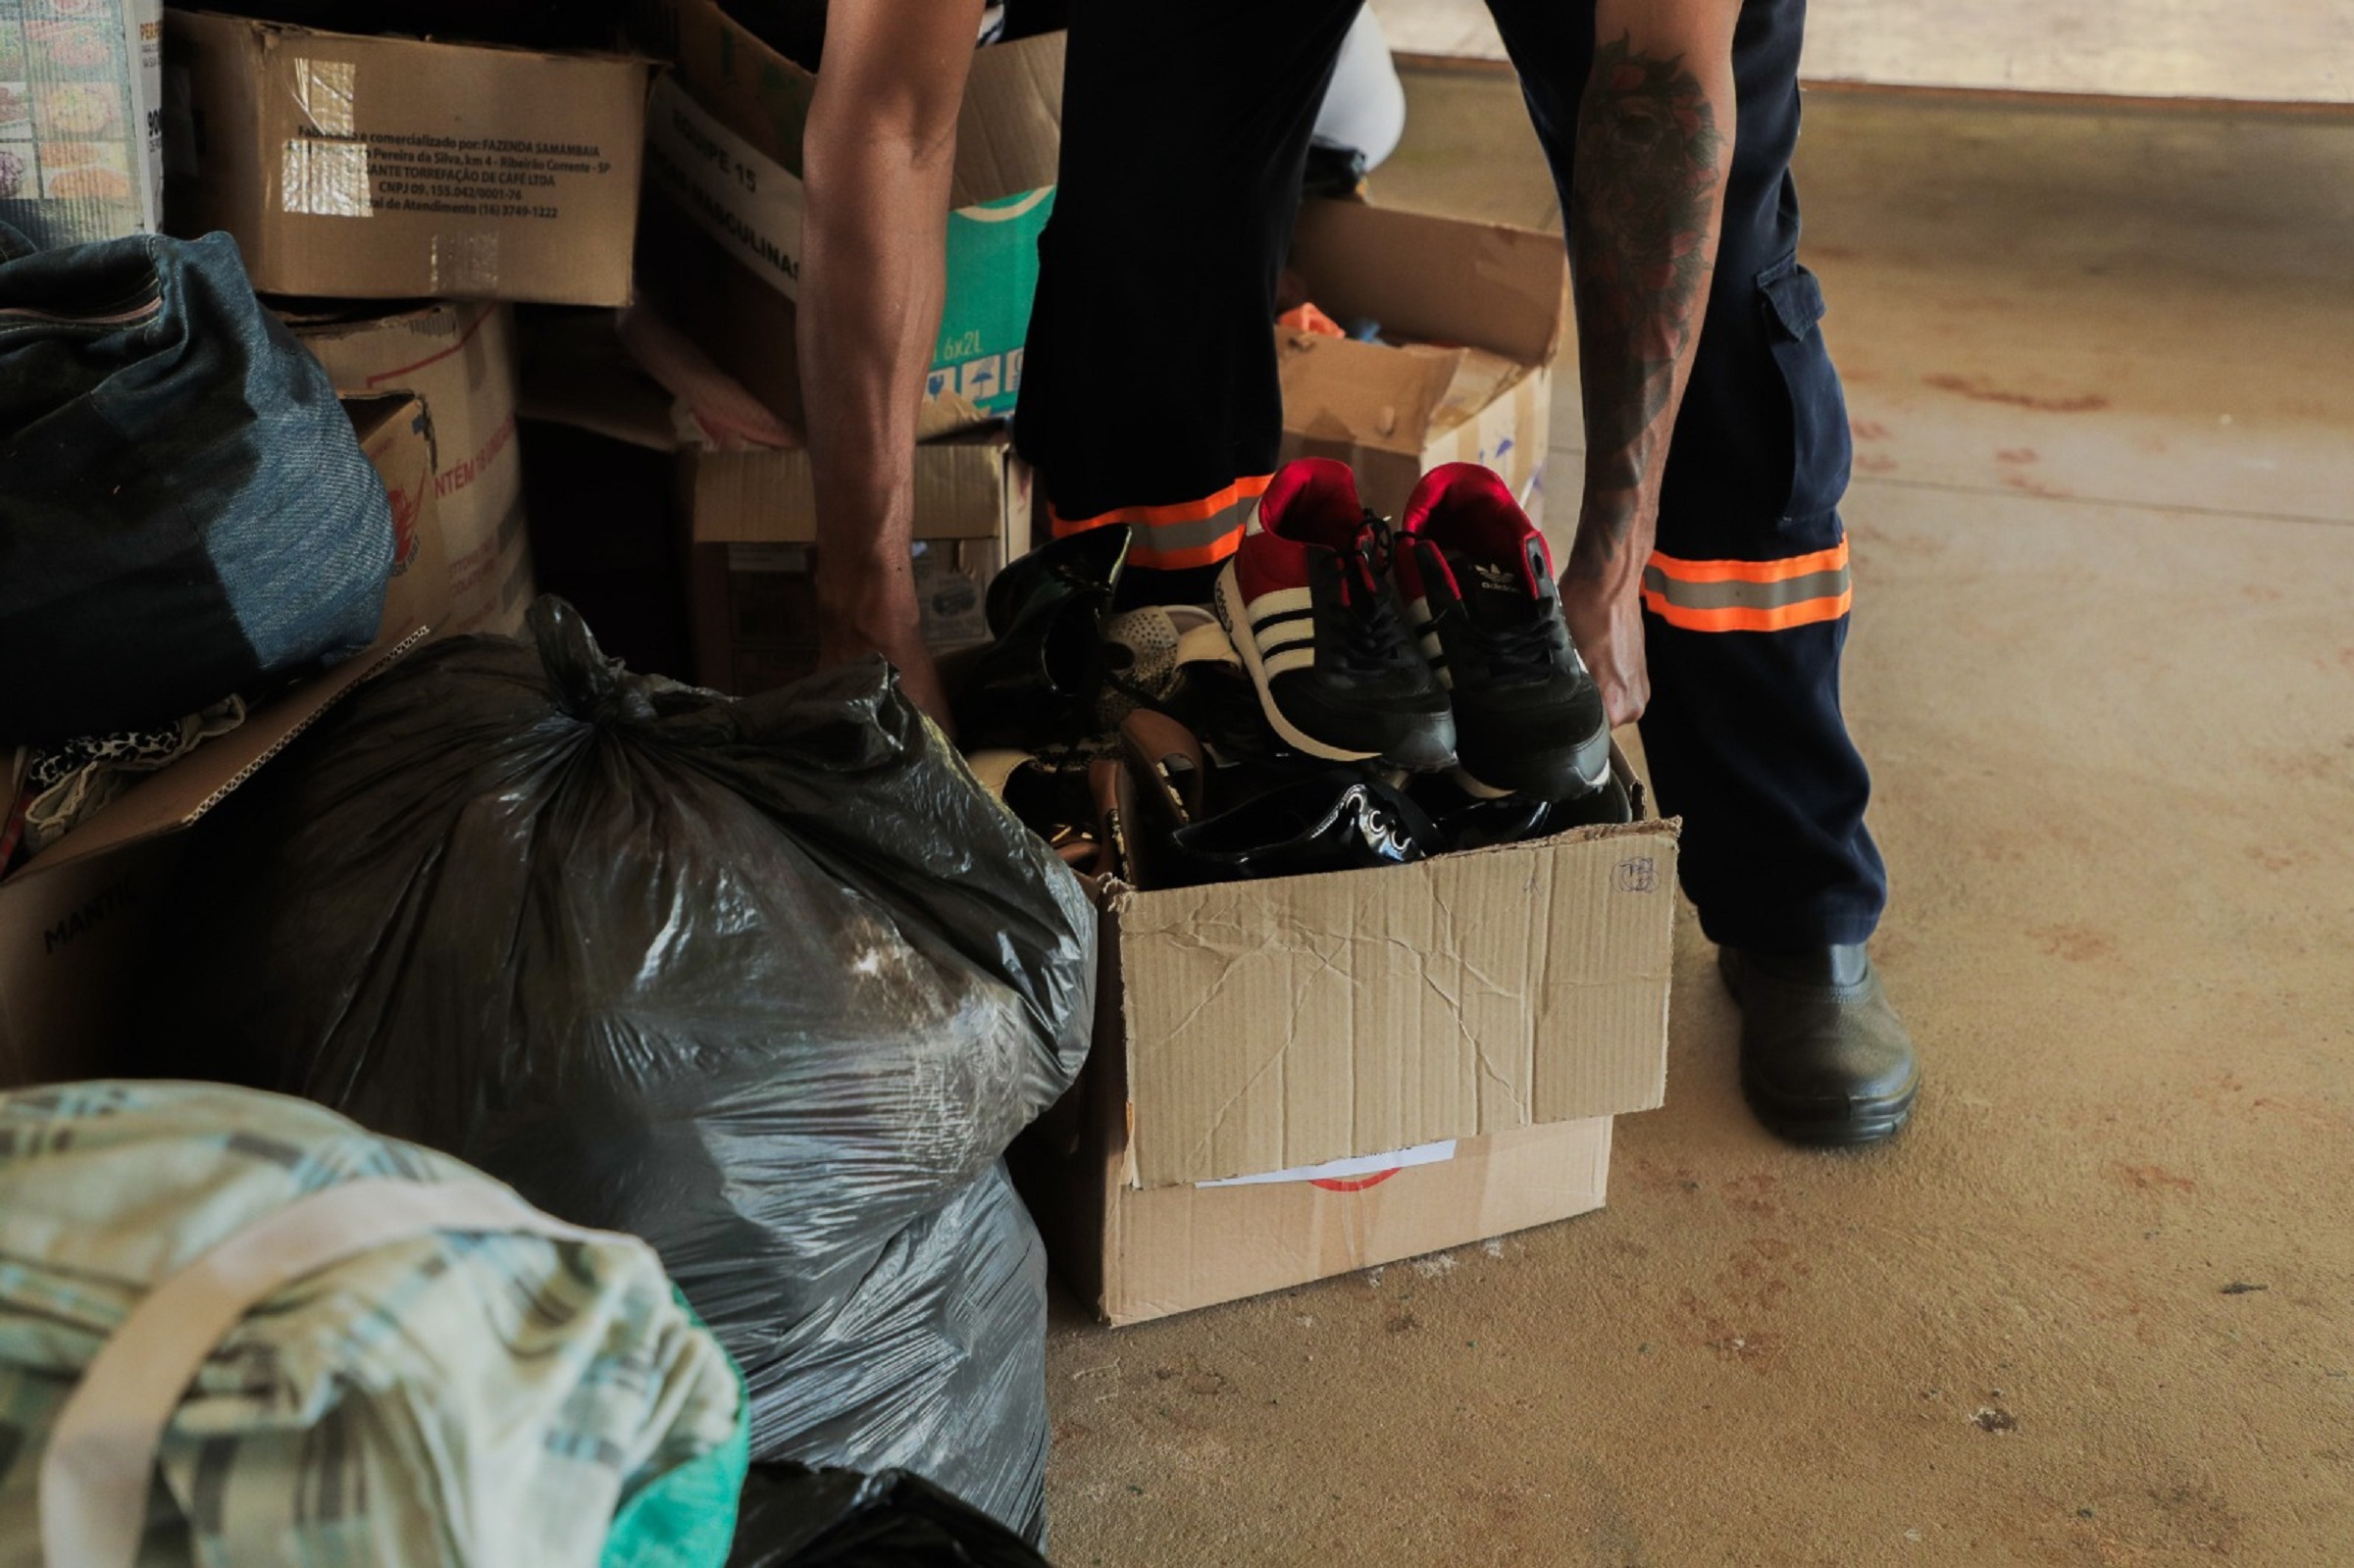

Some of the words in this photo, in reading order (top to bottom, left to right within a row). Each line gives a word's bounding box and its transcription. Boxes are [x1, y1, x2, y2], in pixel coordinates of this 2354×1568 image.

[360, 132, 368, 141] e
[370, 133, 456, 149] comercializado
[458, 139, 480, 153] por:
[483, 139, 533, 154] FAZENDA
[536, 143, 600, 158] SAMAMBAIA
[374, 147, 414, 162] Pereira
[417, 152, 432, 163] da
[485, 155, 492, 167] 4
[500, 156, 544, 171] Ribeirão
[546, 159, 590, 174] Corrente
[598, 162, 612, 175] SP
[379, 180, 408, 194] CNPJ
[403, 165, 479, 183] TORREFAÇÃO
[482, 172, 494, 183] DE
[498, 171, 525, 185] CAFÉ
[528, 175, 556, 187] LTDA
[736, 163, 756, 193] 15
[386, 197, 401, 210] de
[403, 198, 477, 215] Atendimento
[479, 203, 500, 218] (16)
[502, 205, 558, 219] 3749-1222
